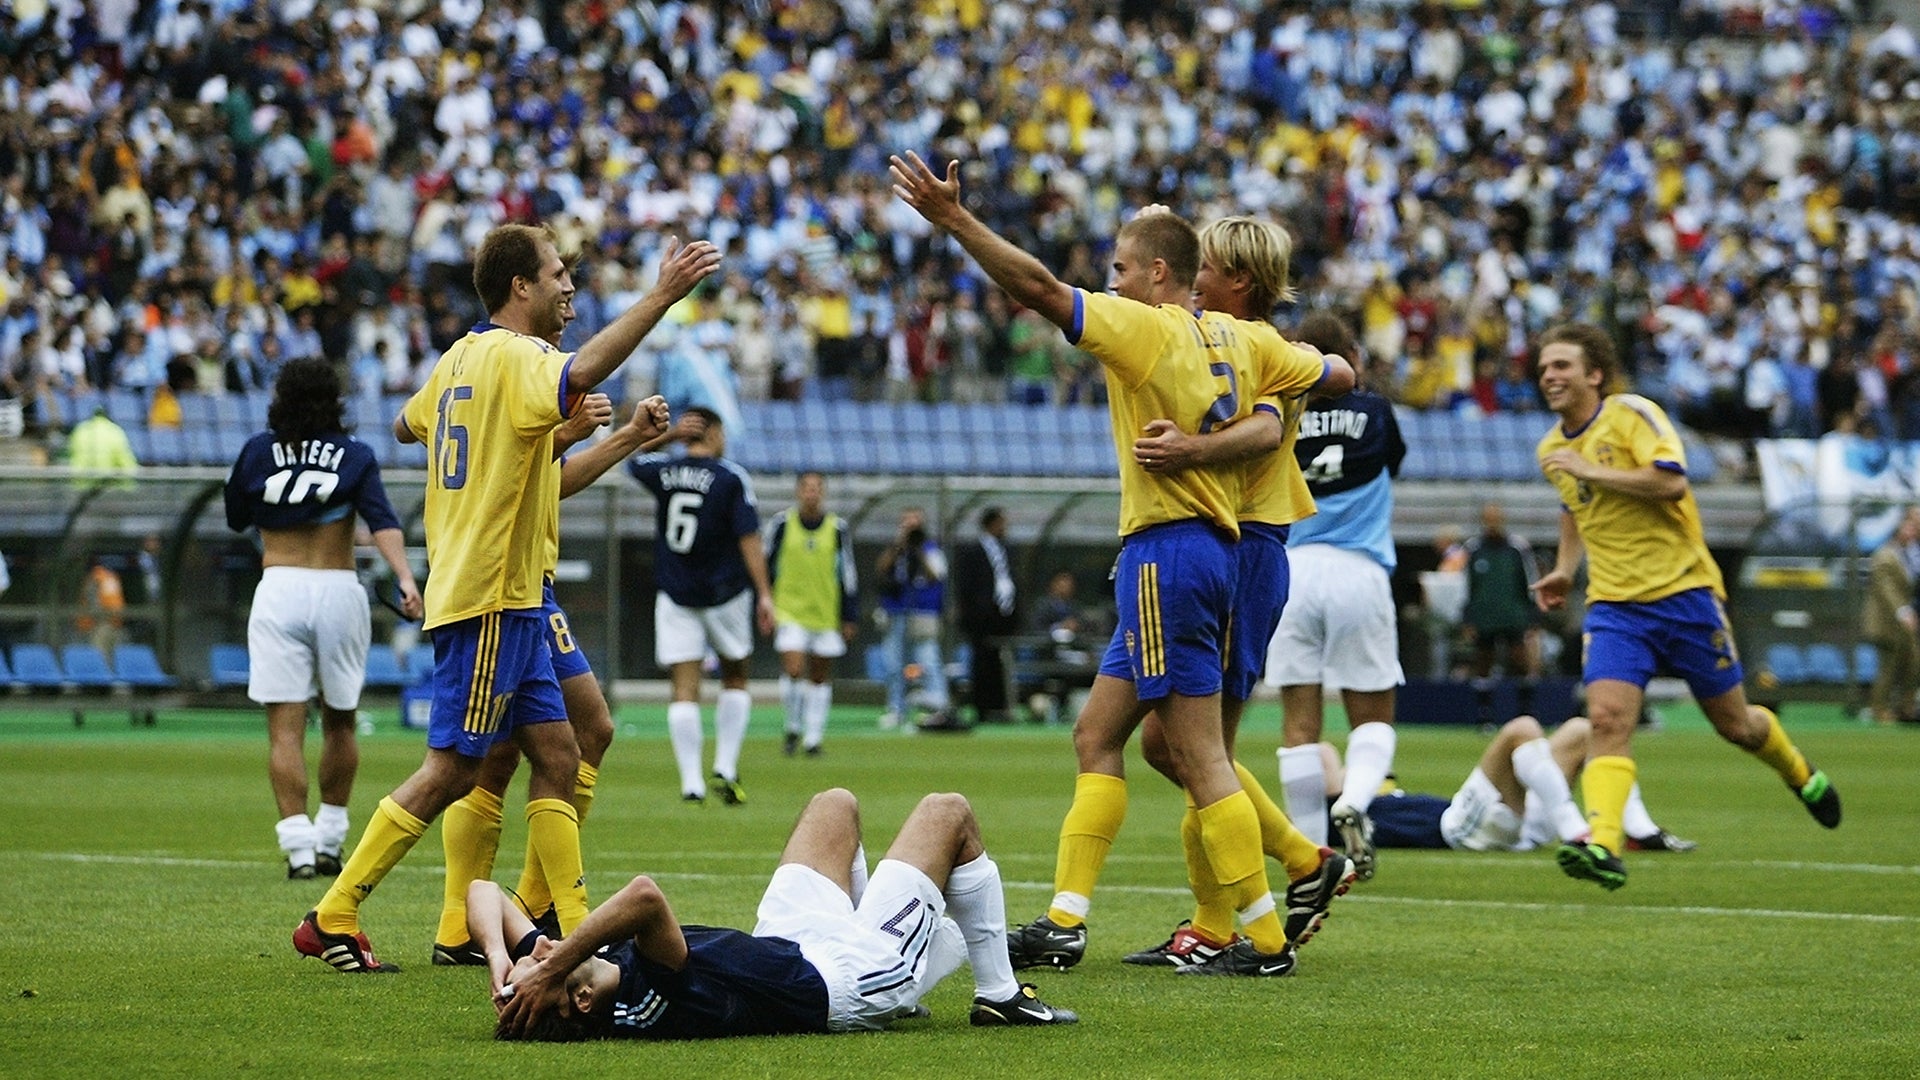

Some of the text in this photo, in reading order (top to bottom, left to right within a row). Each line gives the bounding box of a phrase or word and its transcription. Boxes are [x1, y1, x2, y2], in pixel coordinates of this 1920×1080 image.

[1199, 361, 1238, 435] 2
[665, 491, 704, 555] 6
[549, 612, 576, 654] 8
[880, 897, 921, 938] 7
